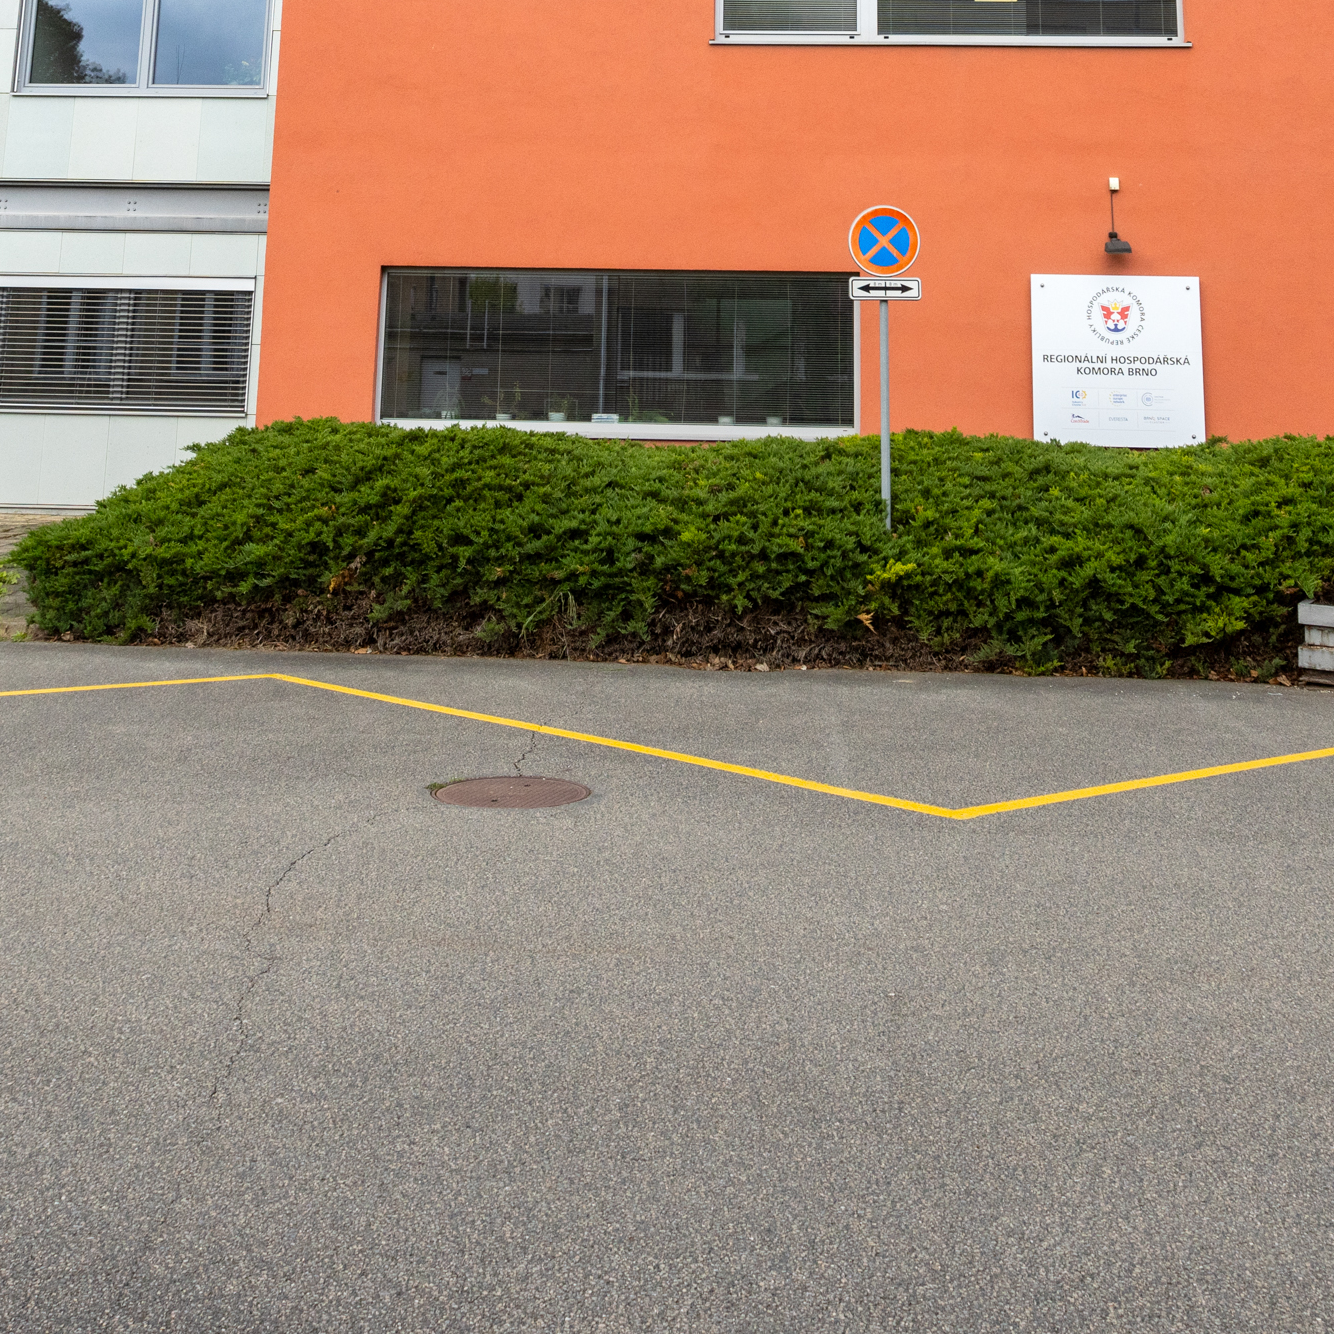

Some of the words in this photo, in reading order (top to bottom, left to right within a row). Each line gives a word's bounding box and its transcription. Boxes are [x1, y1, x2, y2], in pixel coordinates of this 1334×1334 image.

[1127, 291, 1146, 323] KOMORA
[1088, 323, 1125, 346] REPUBLIKY
[1042, 353, 1108, 364] REGIONÁLNÍ
[1110, 354, 1191, 366] HOSPODÁŘSKÁ
[1076, 366, 1125, 376] KOMORA
[1127, 367, 1158, 377] BRNO
